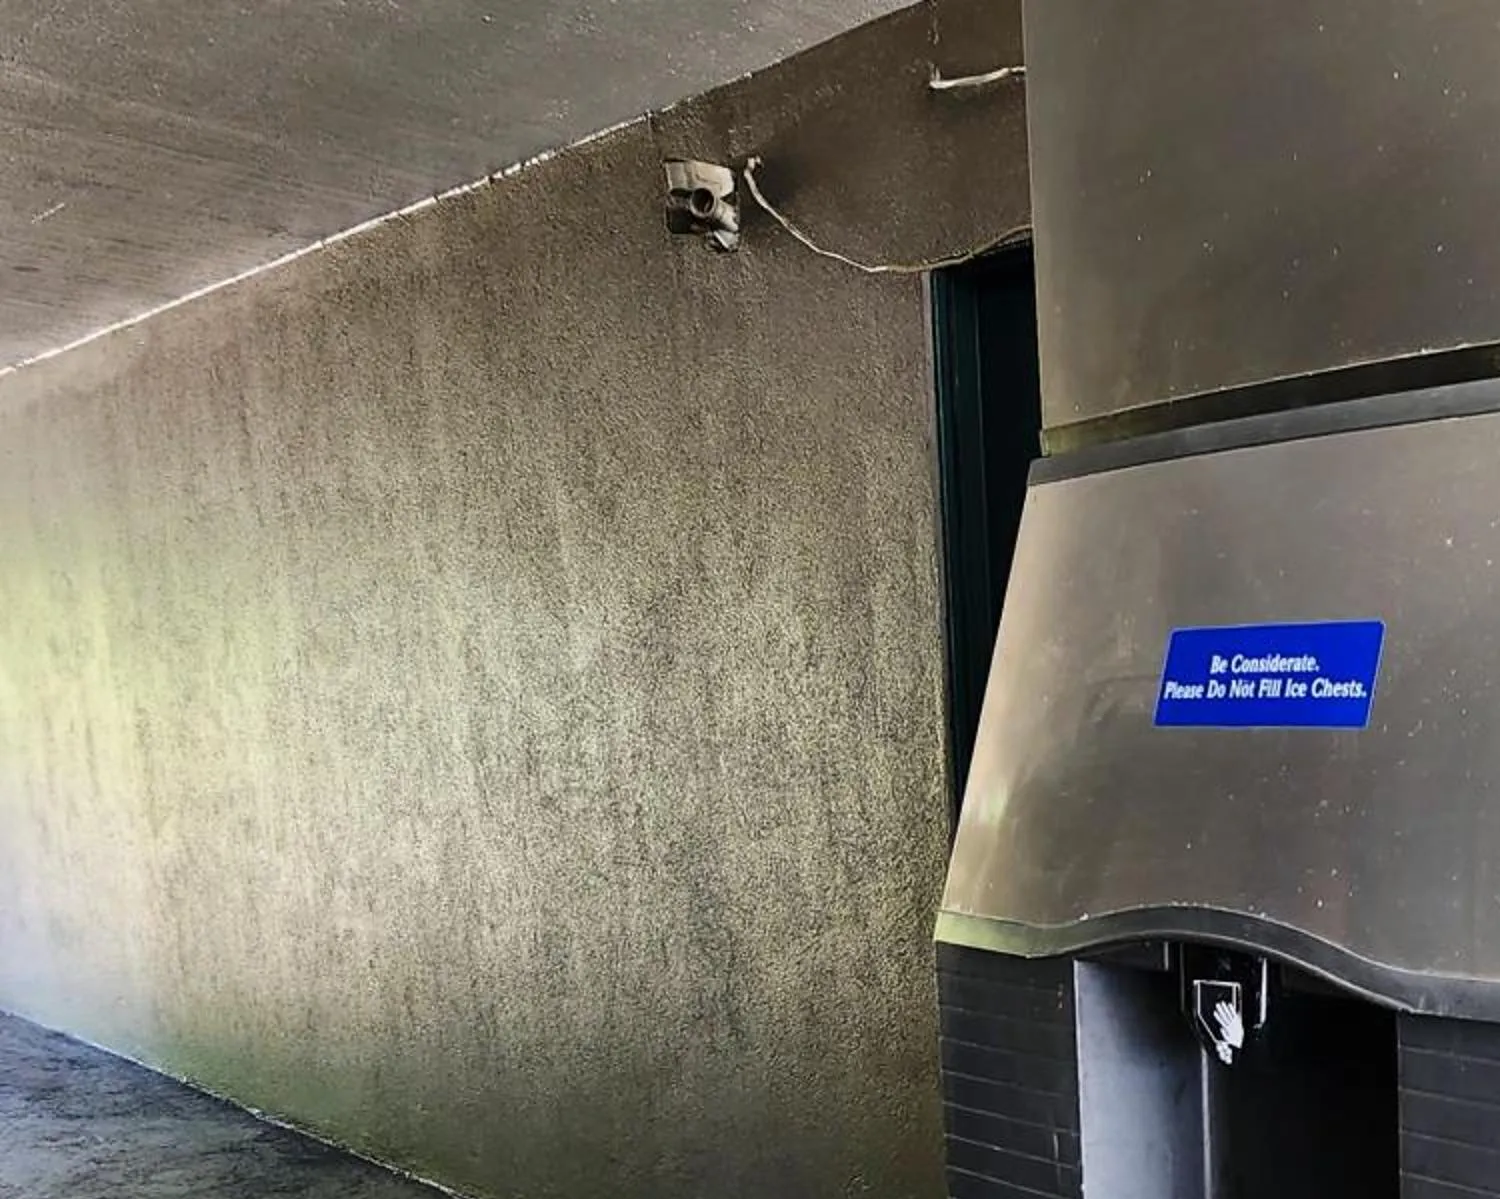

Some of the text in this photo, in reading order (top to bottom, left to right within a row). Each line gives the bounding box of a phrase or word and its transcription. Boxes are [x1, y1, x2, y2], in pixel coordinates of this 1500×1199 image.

[1210, 653, 1320, 674] Be Considerate.
[1164, 677, 1368, 700] Please Do Not Fill Ice Chests.
